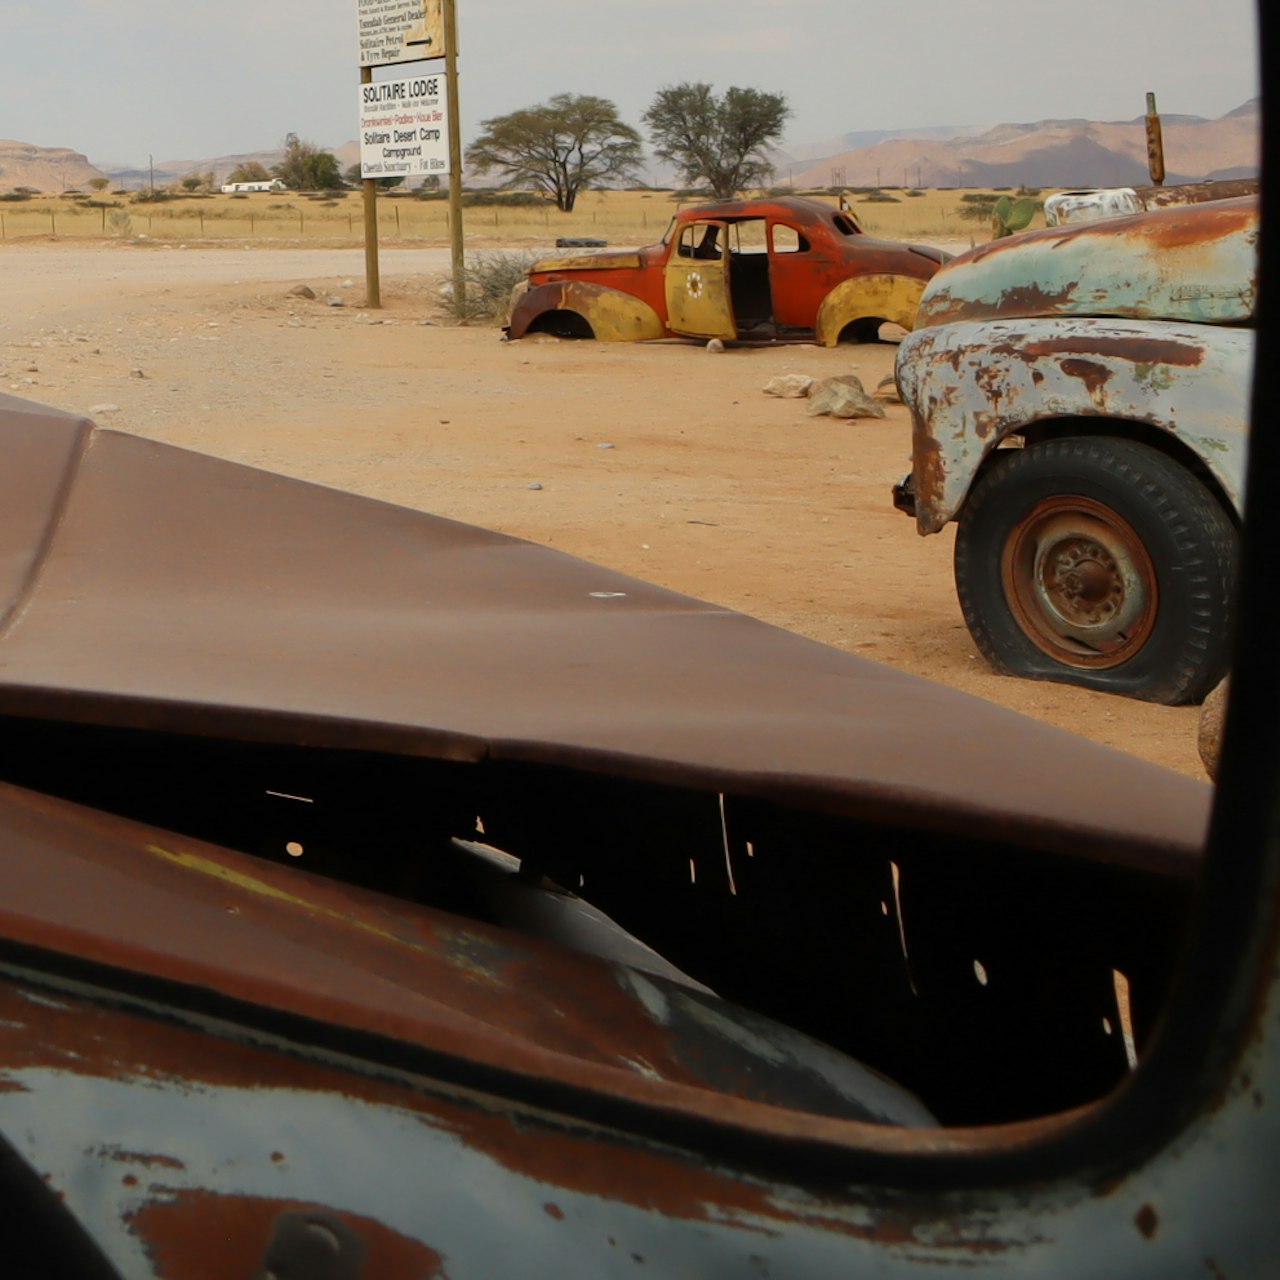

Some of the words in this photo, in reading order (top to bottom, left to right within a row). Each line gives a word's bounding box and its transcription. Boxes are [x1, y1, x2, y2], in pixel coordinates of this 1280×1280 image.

[383, 12, 406, 25] General
[360, 37, 384, 49] Solitaire
[386, 34, 404, 45] Petrol
[366, 50, 380, 62] Tyre
[382, 48, 400, 61] Repair
[363, 83, 405, 103] SOLITAIRE
[409, 78, 438, 98] LODGE
[364, 130, 390, 145] Solitaire
[394, 129, 416, 143] Desert
[420, 127, 440, 142] Camp
[382, 144, 421, 160] Campground
